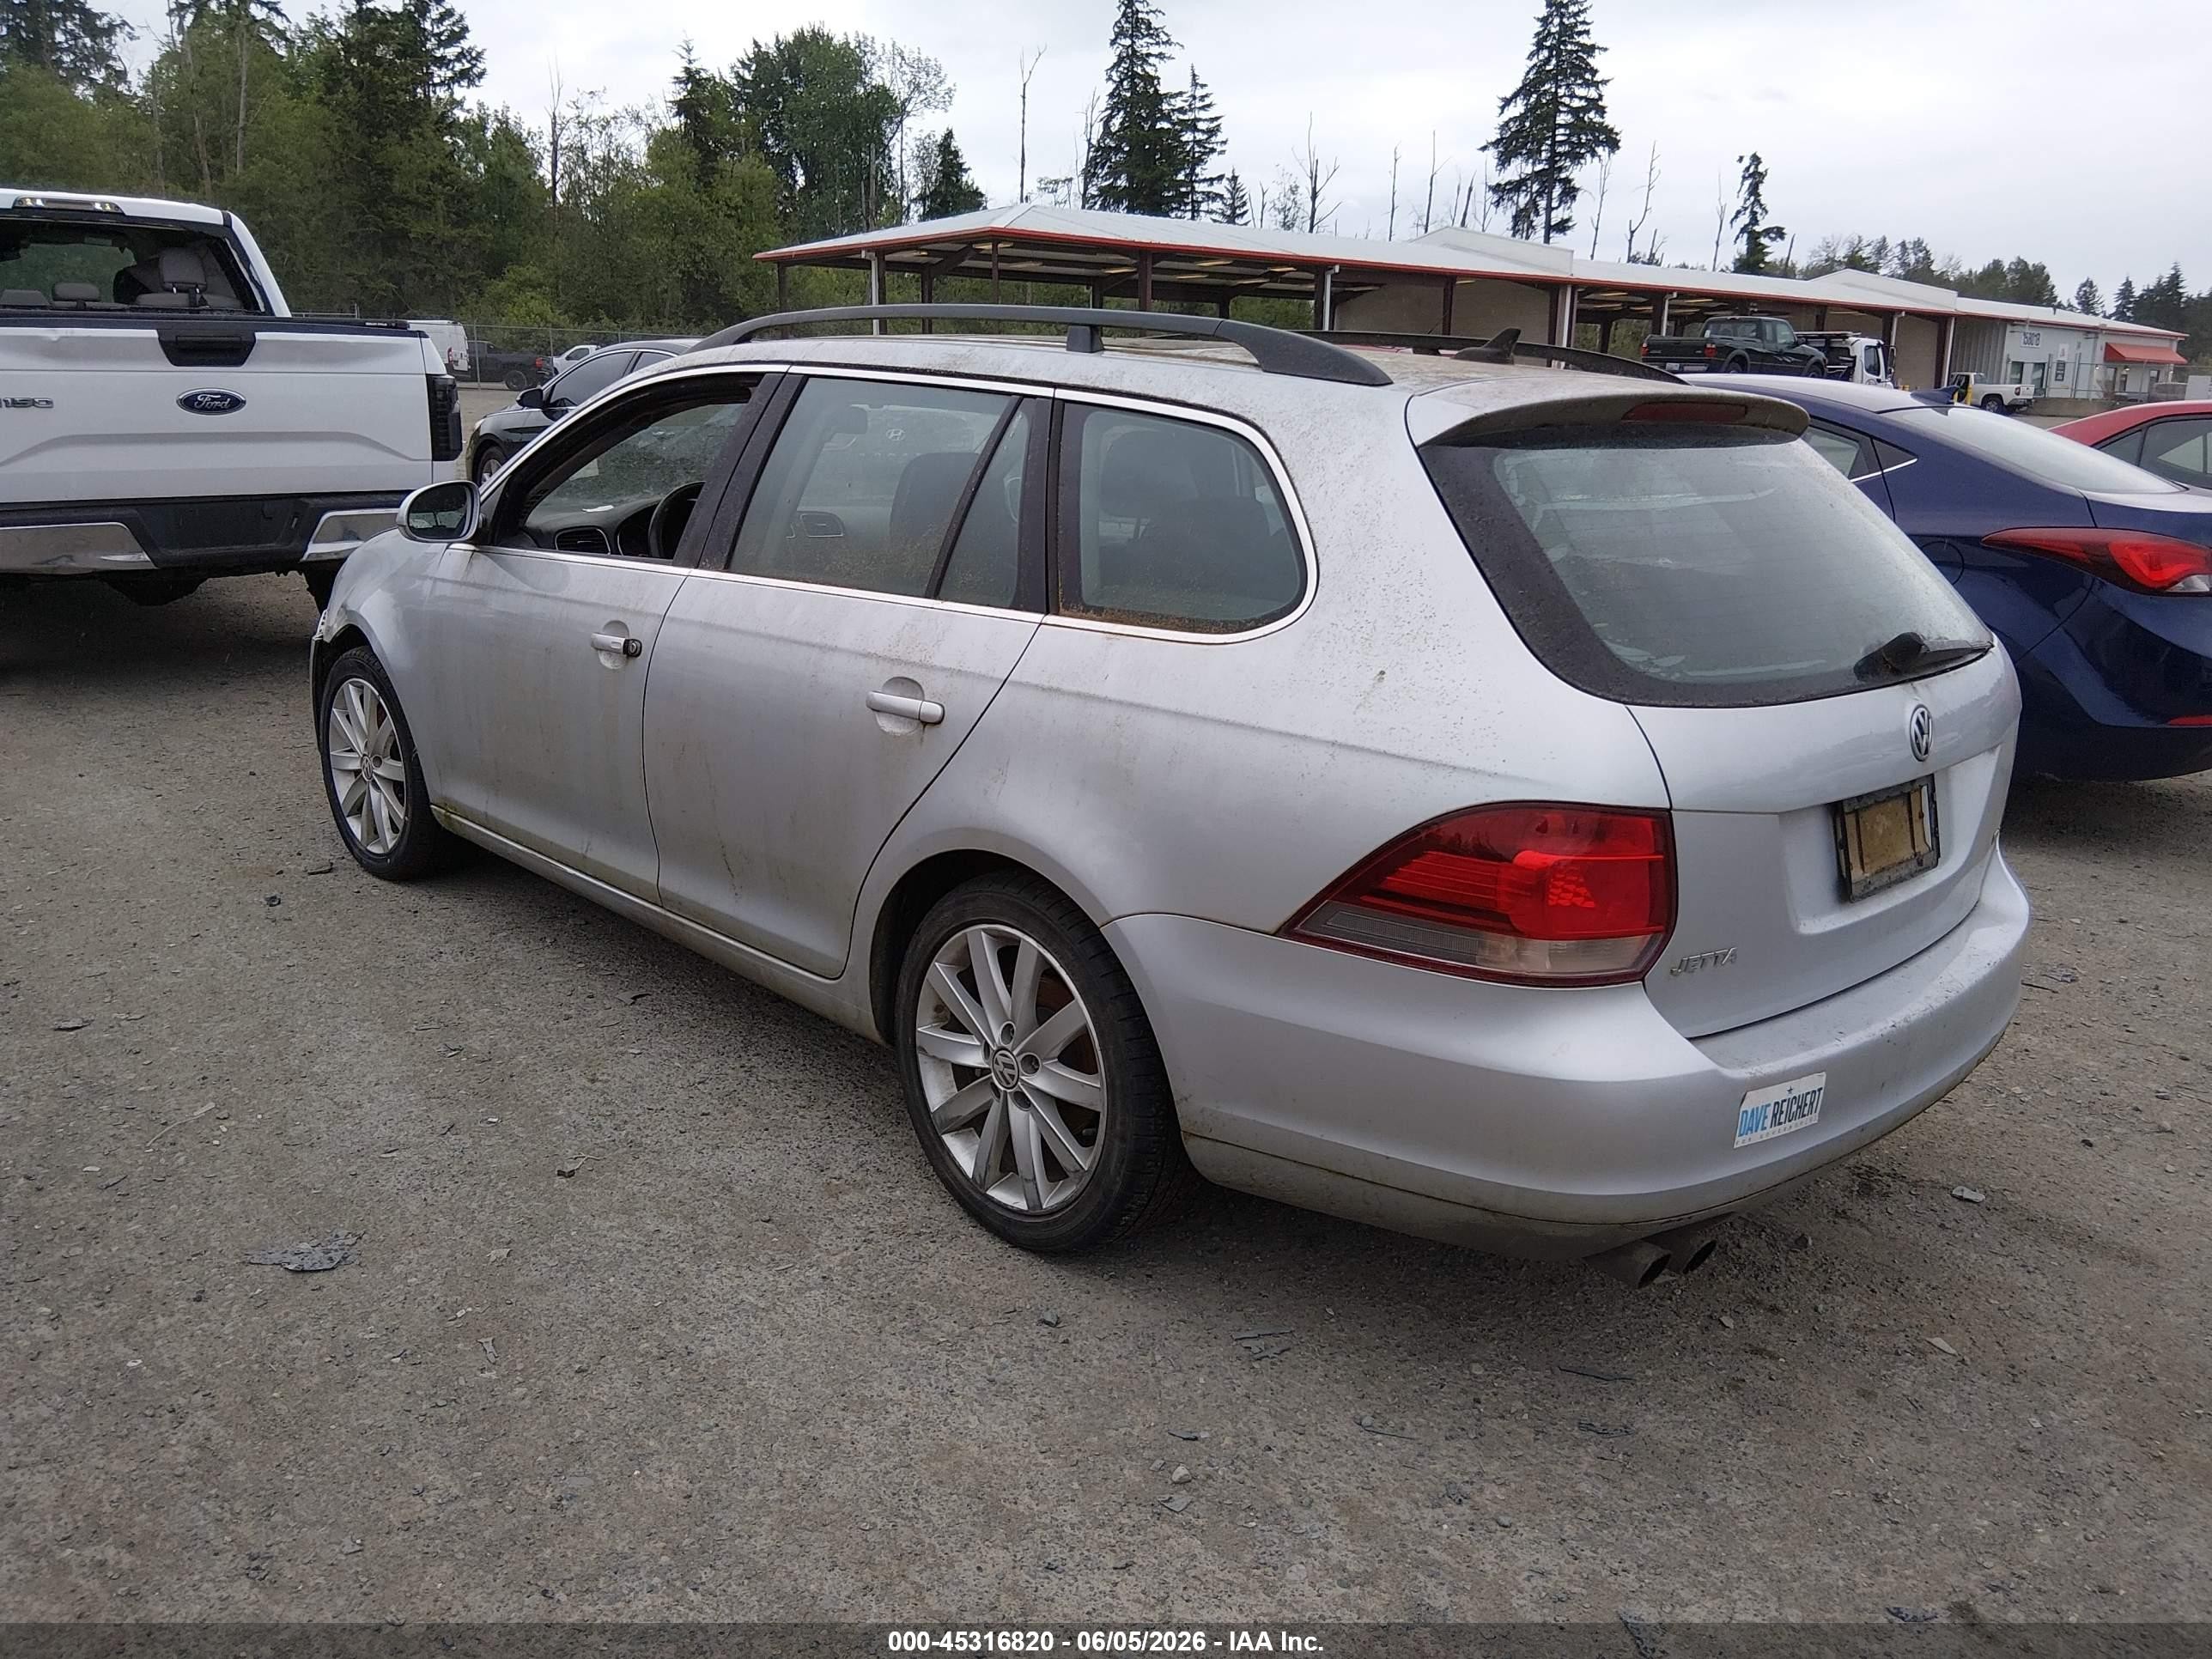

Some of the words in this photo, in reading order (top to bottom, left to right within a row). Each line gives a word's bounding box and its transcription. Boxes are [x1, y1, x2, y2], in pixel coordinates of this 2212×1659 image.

[0, 397, 54, 409] 150
[194, 394, 231, 409] Ford
[1670, 947, 1737, 975] JETTA
[1737, 1103, 1771, 1138] DAVE
[1770, 1087, 1823, 1128] REICHERT
